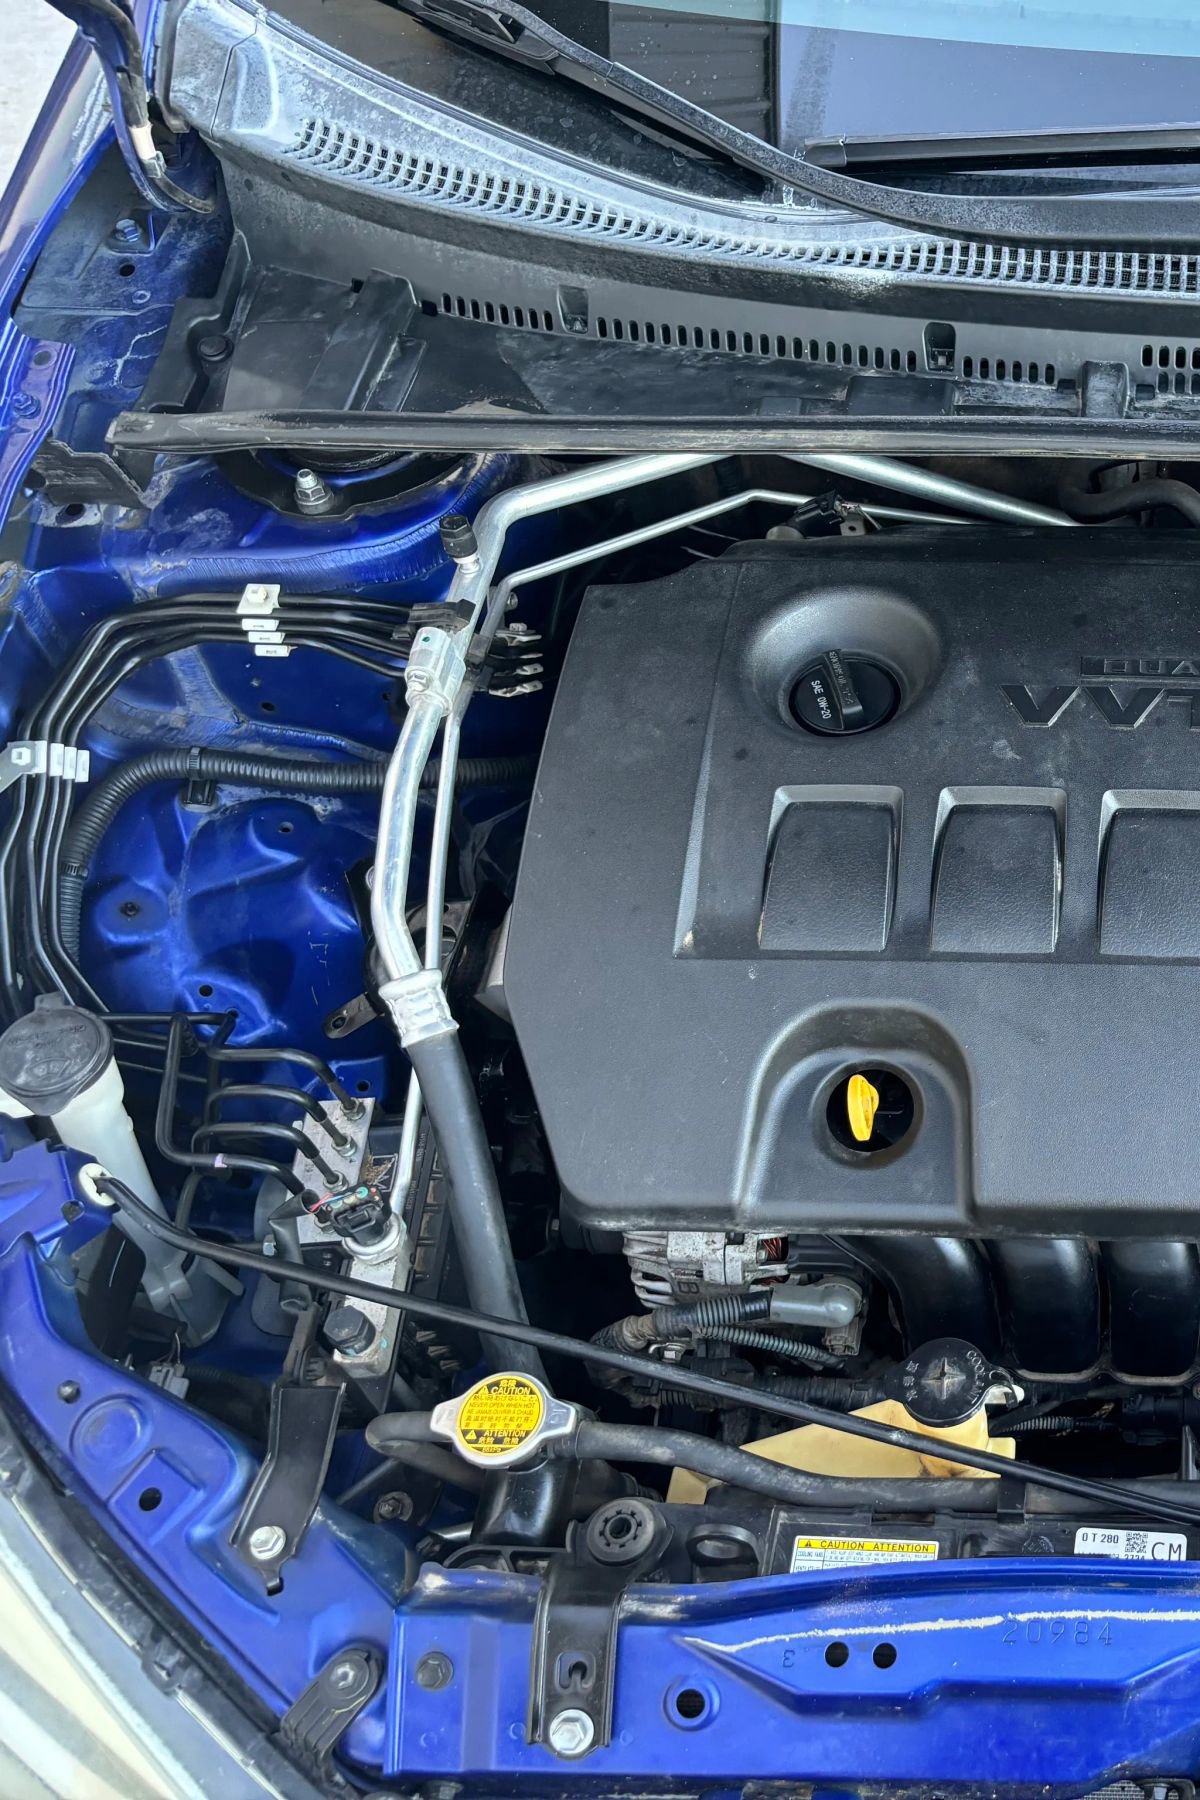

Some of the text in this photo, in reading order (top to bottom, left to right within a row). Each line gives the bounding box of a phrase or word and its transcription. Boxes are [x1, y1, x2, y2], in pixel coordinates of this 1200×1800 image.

[811, 680, 832, 720] SAE 0W-20
[491, 1386, 531, 1395] CAUTION
[484, 1429, 526, 1437] ATTENTION
[1092, 1533, 1098, 1543] T
[1100, 1533, 1119, 1544] 280
[820, 1540, 929, 1552] CAUTION ATTENTION
[1151, 1541, 1182, 1560] CM
[1001, 1619, 1113, 1646] 20984
